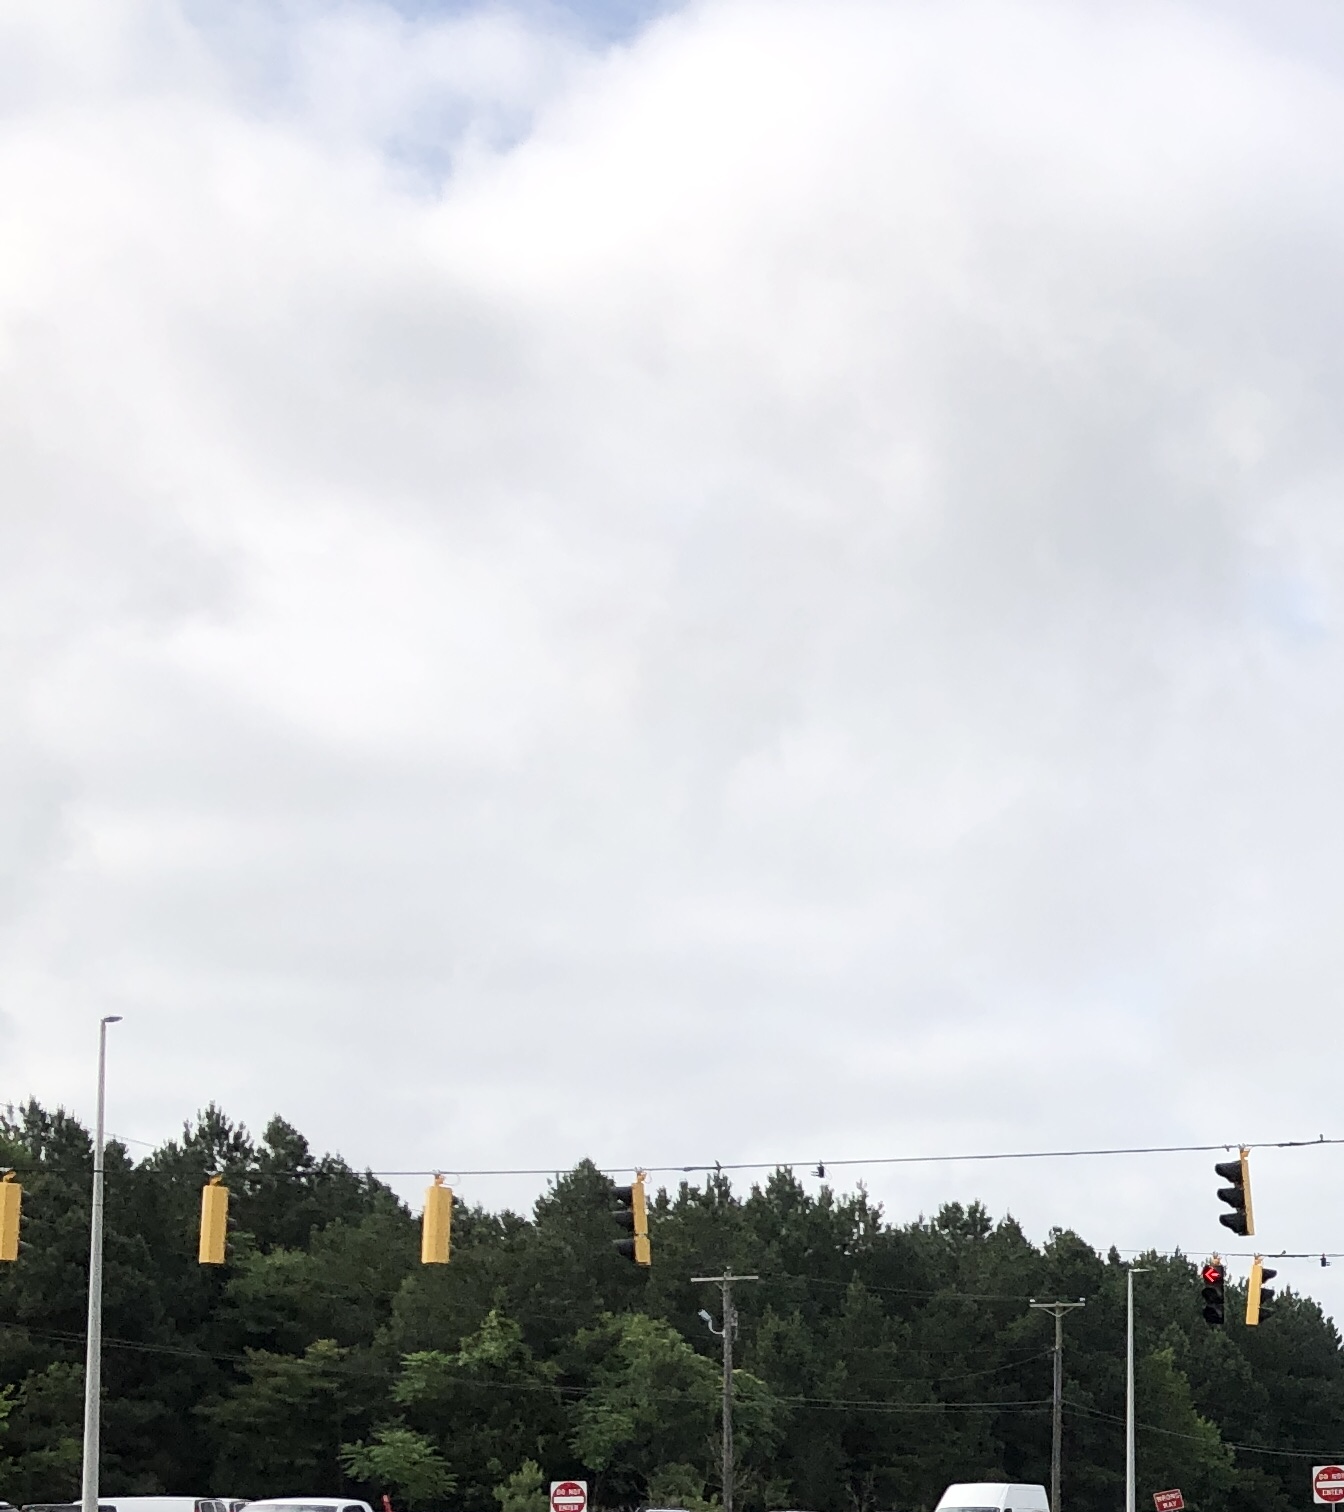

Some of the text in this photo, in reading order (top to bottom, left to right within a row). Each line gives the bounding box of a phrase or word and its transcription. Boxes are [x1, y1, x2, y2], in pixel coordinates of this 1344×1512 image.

[1331, 1472, 1344, 1480] NOT
[556, 1488, 582, 1496] DO NOT
[1322, 1488, 1344, 1496] ENTER
[1155, 1492, 1180, 1503] WRONG
[558, 1504, 579, 1512] ENTER
[1162, 1500, 1177, 1509] WAY
